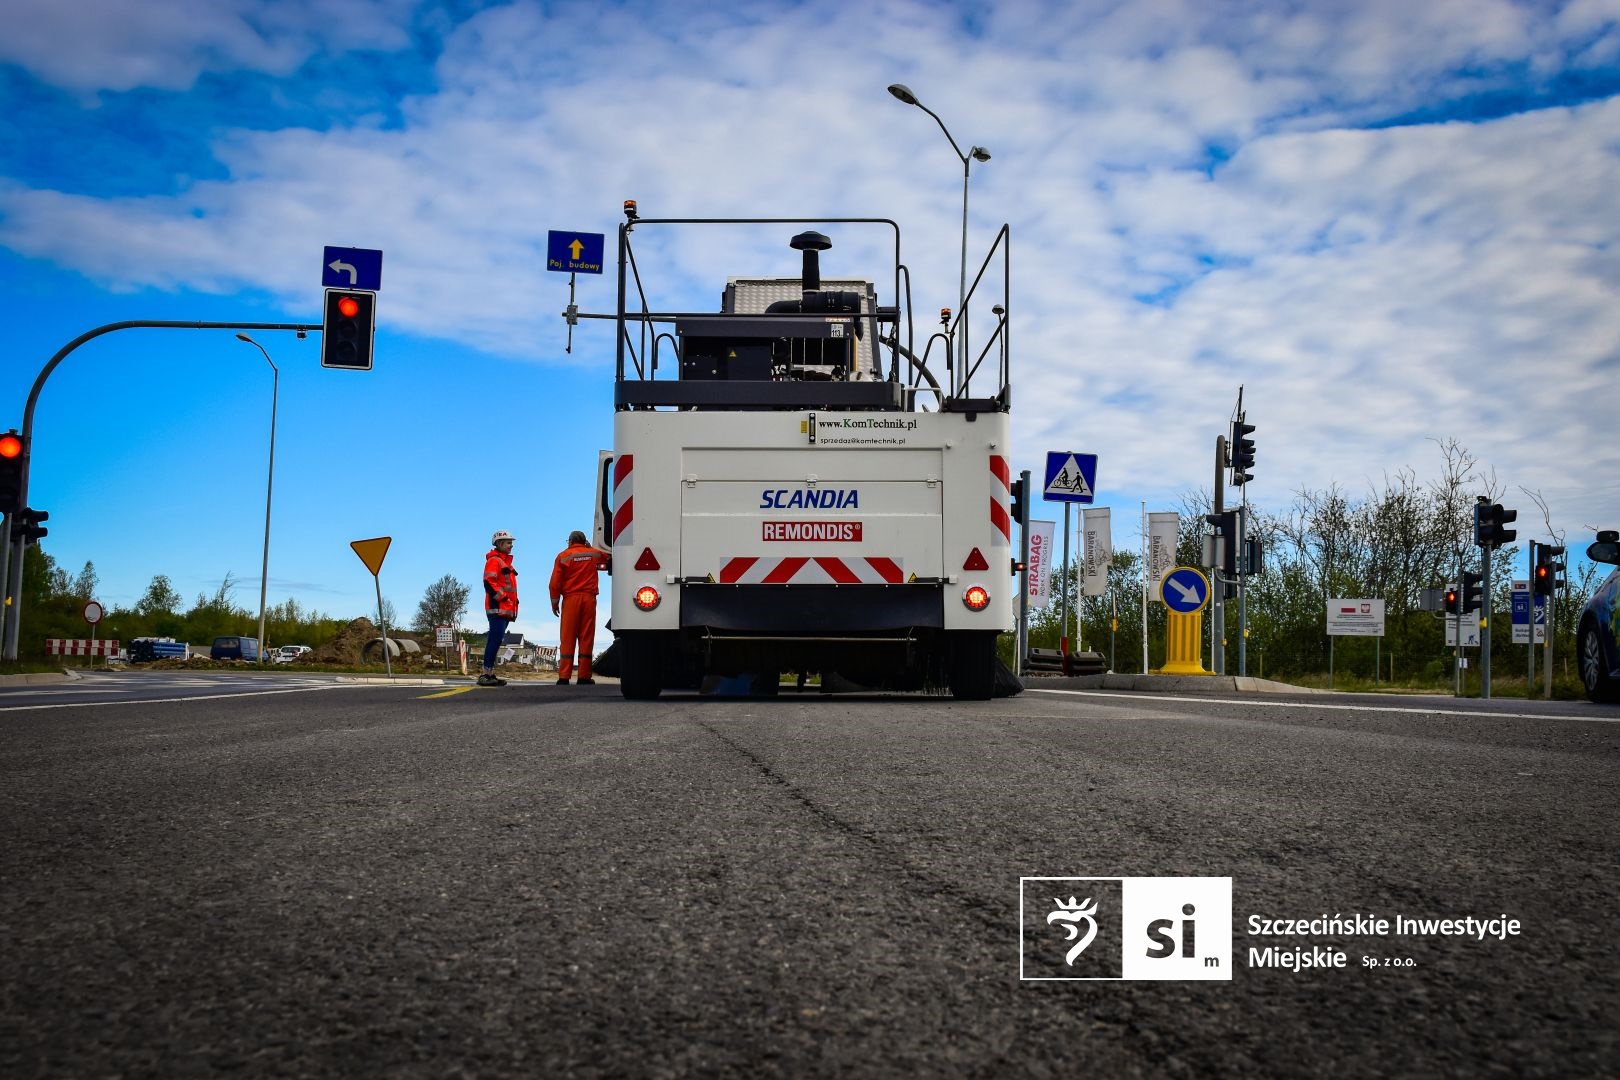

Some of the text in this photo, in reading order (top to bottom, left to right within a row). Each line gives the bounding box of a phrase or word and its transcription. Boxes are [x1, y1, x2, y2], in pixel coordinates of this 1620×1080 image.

[569, 260, 600, 271] budowy
[818, 418, 918, 431] www.KomTechnik.pl
[759, 489, 860, 509] SCANDIA
[1041, 535, 1049, 566] PROGRESS
[1087, 530, 1097, 577] BARANOWSKI
[1152, 535, 1162, 582] BARANOWSKI
[1028, 534, 1042, 596] STRABAG
[1040, 567, 1046, 578] ON
